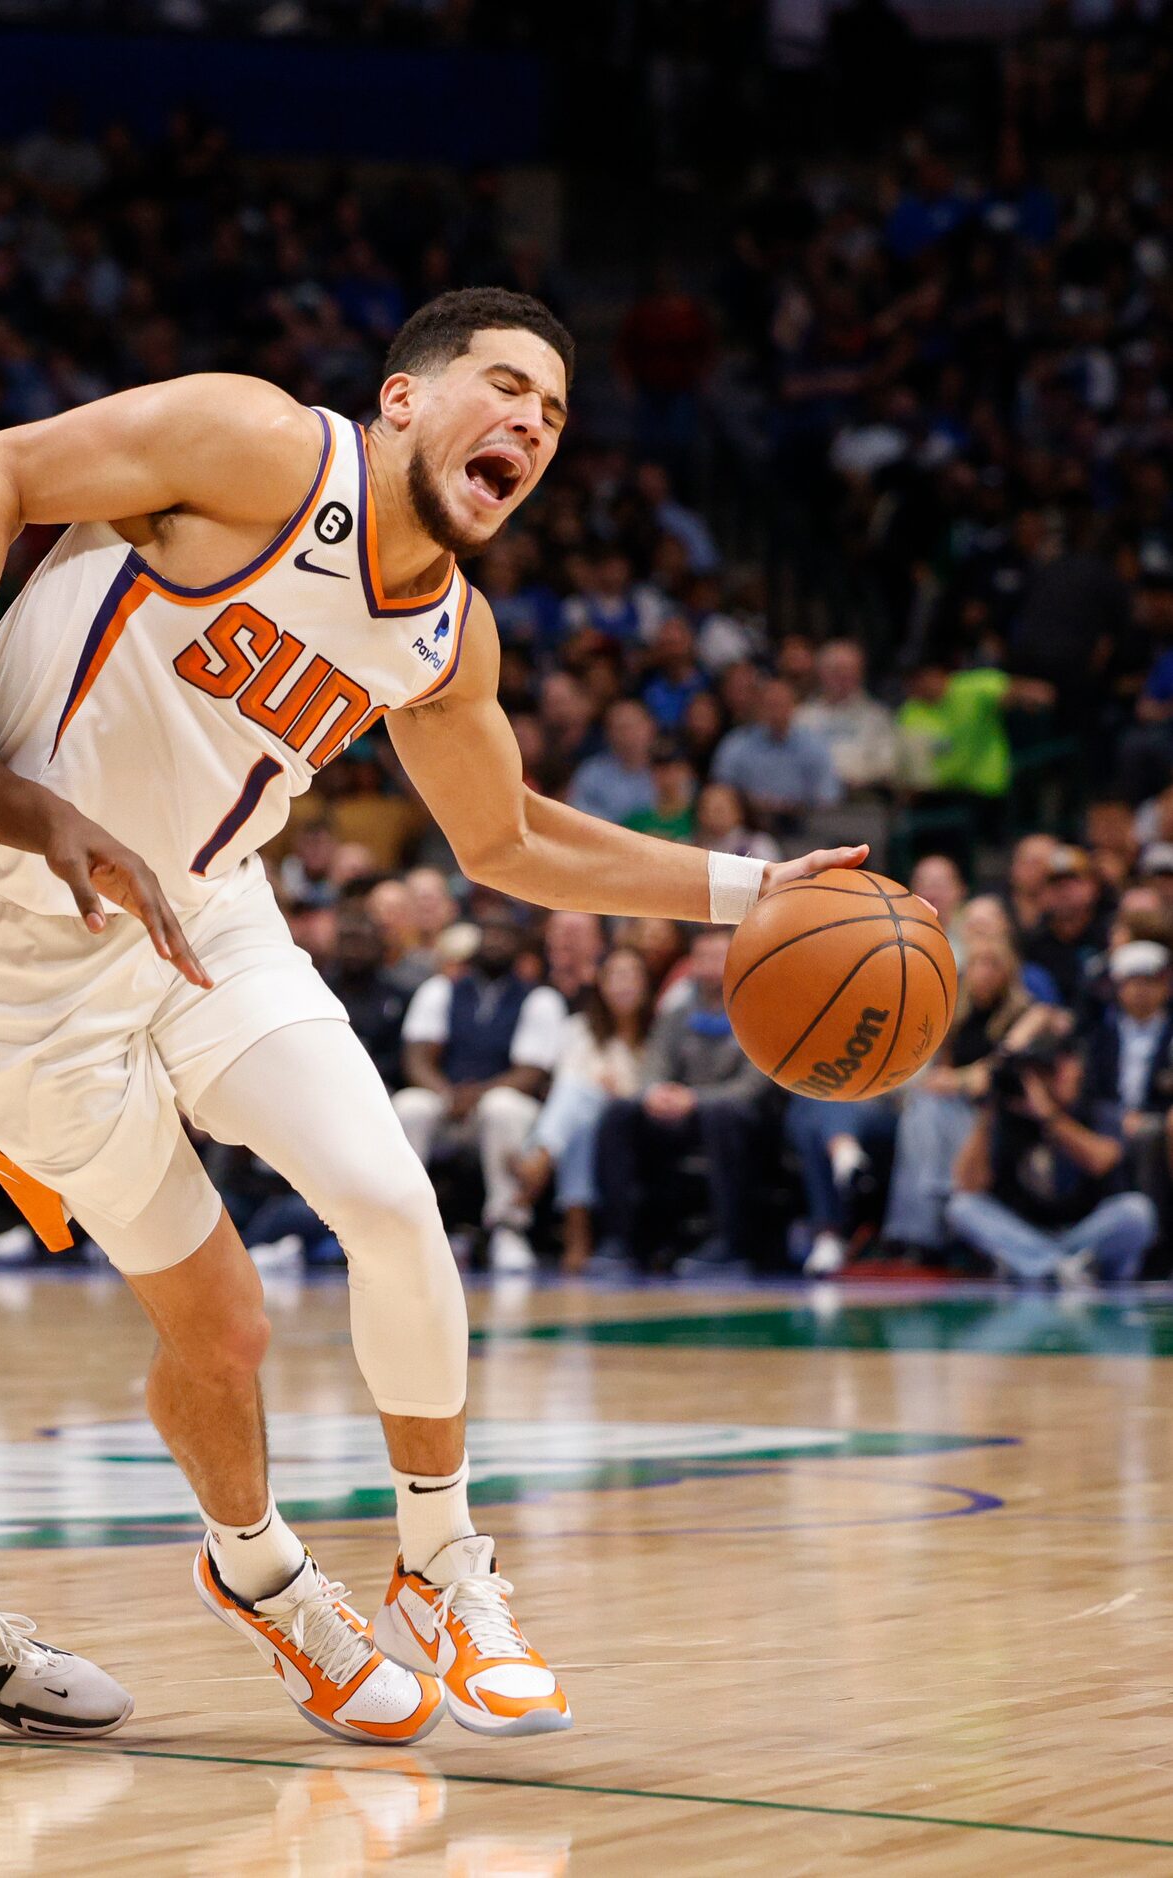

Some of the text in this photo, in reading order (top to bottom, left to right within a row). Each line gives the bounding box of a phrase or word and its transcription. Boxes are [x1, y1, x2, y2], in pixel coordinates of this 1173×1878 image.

[320, 507, 346, 539] 6
[173, 602, 390, 770] SUN
[412, 637, 445, 671] PayPal
[189, 752, 284, 877] 1
